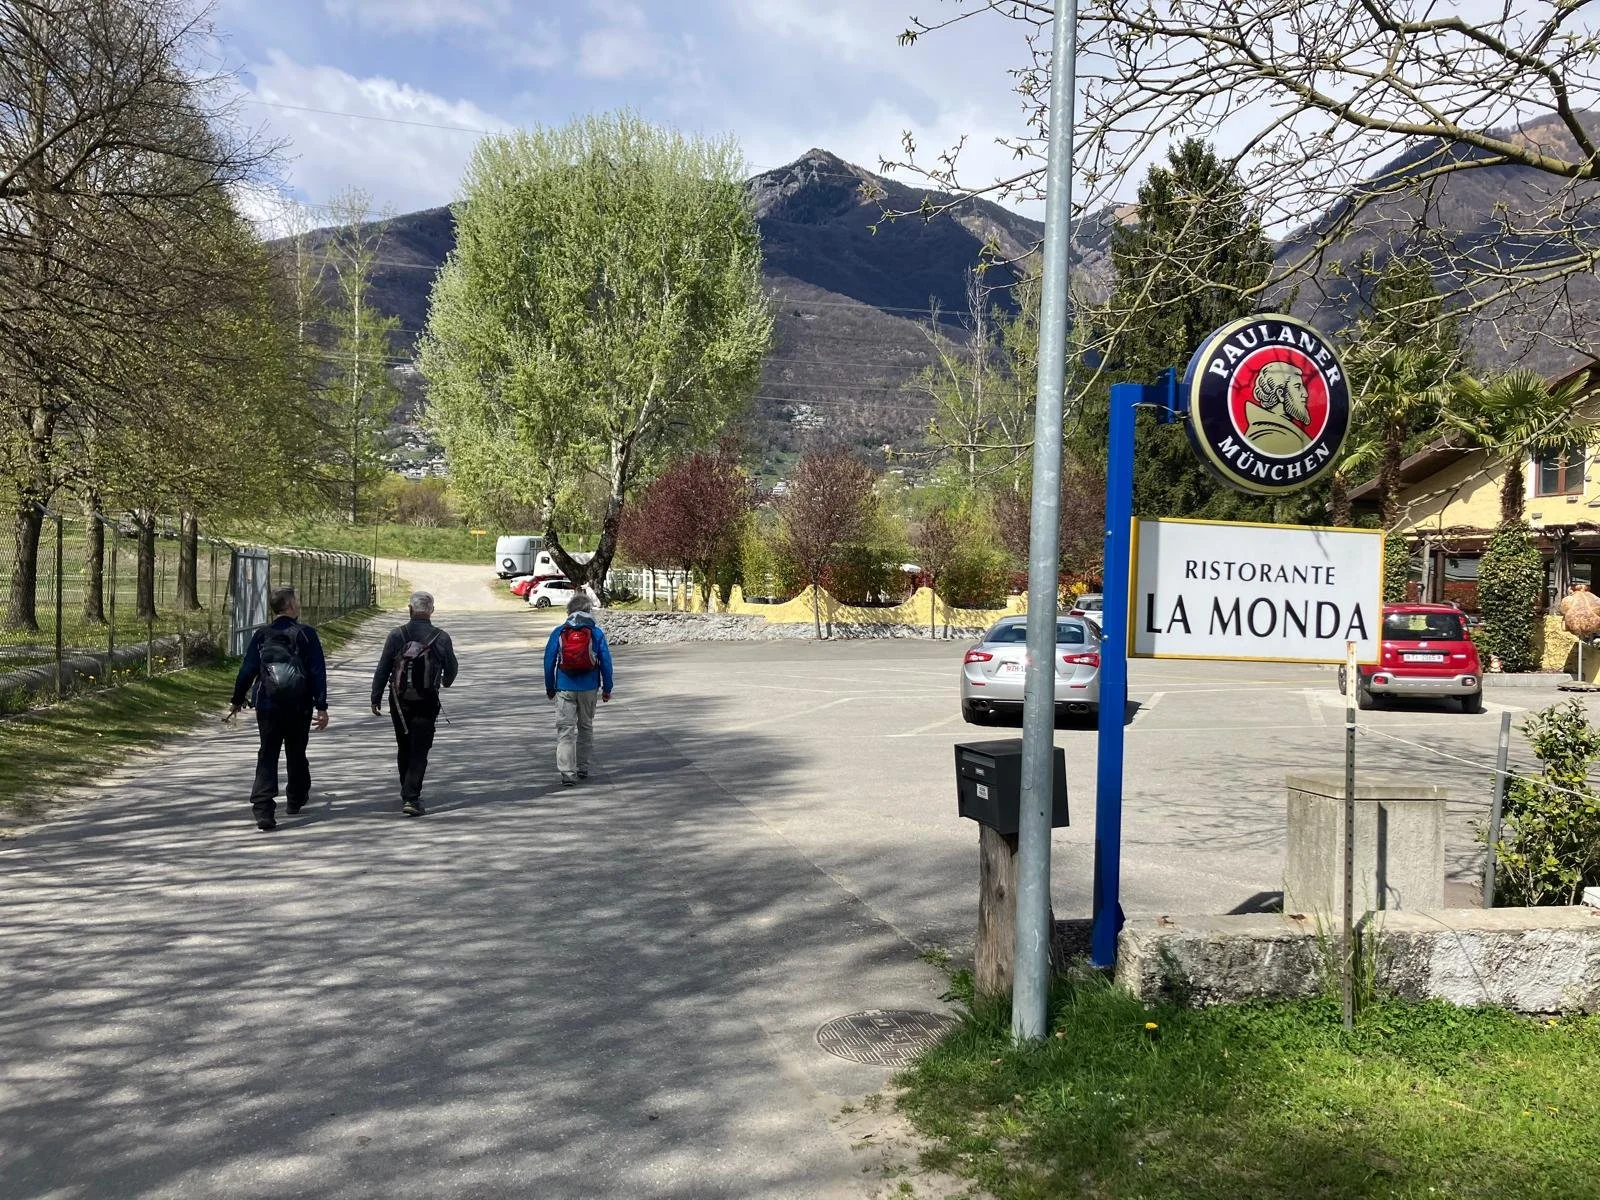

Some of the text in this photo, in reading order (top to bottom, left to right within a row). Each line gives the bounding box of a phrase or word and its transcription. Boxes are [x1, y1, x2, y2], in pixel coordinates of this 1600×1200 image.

[1209, 324, 1342, 387] PAULANER
[1217, 435, 1331, 481] MÜNCHEN
[1185, 559, 1336, 586] RISTORANTE
[1145, 592, 1369, 641] LA MONDA
